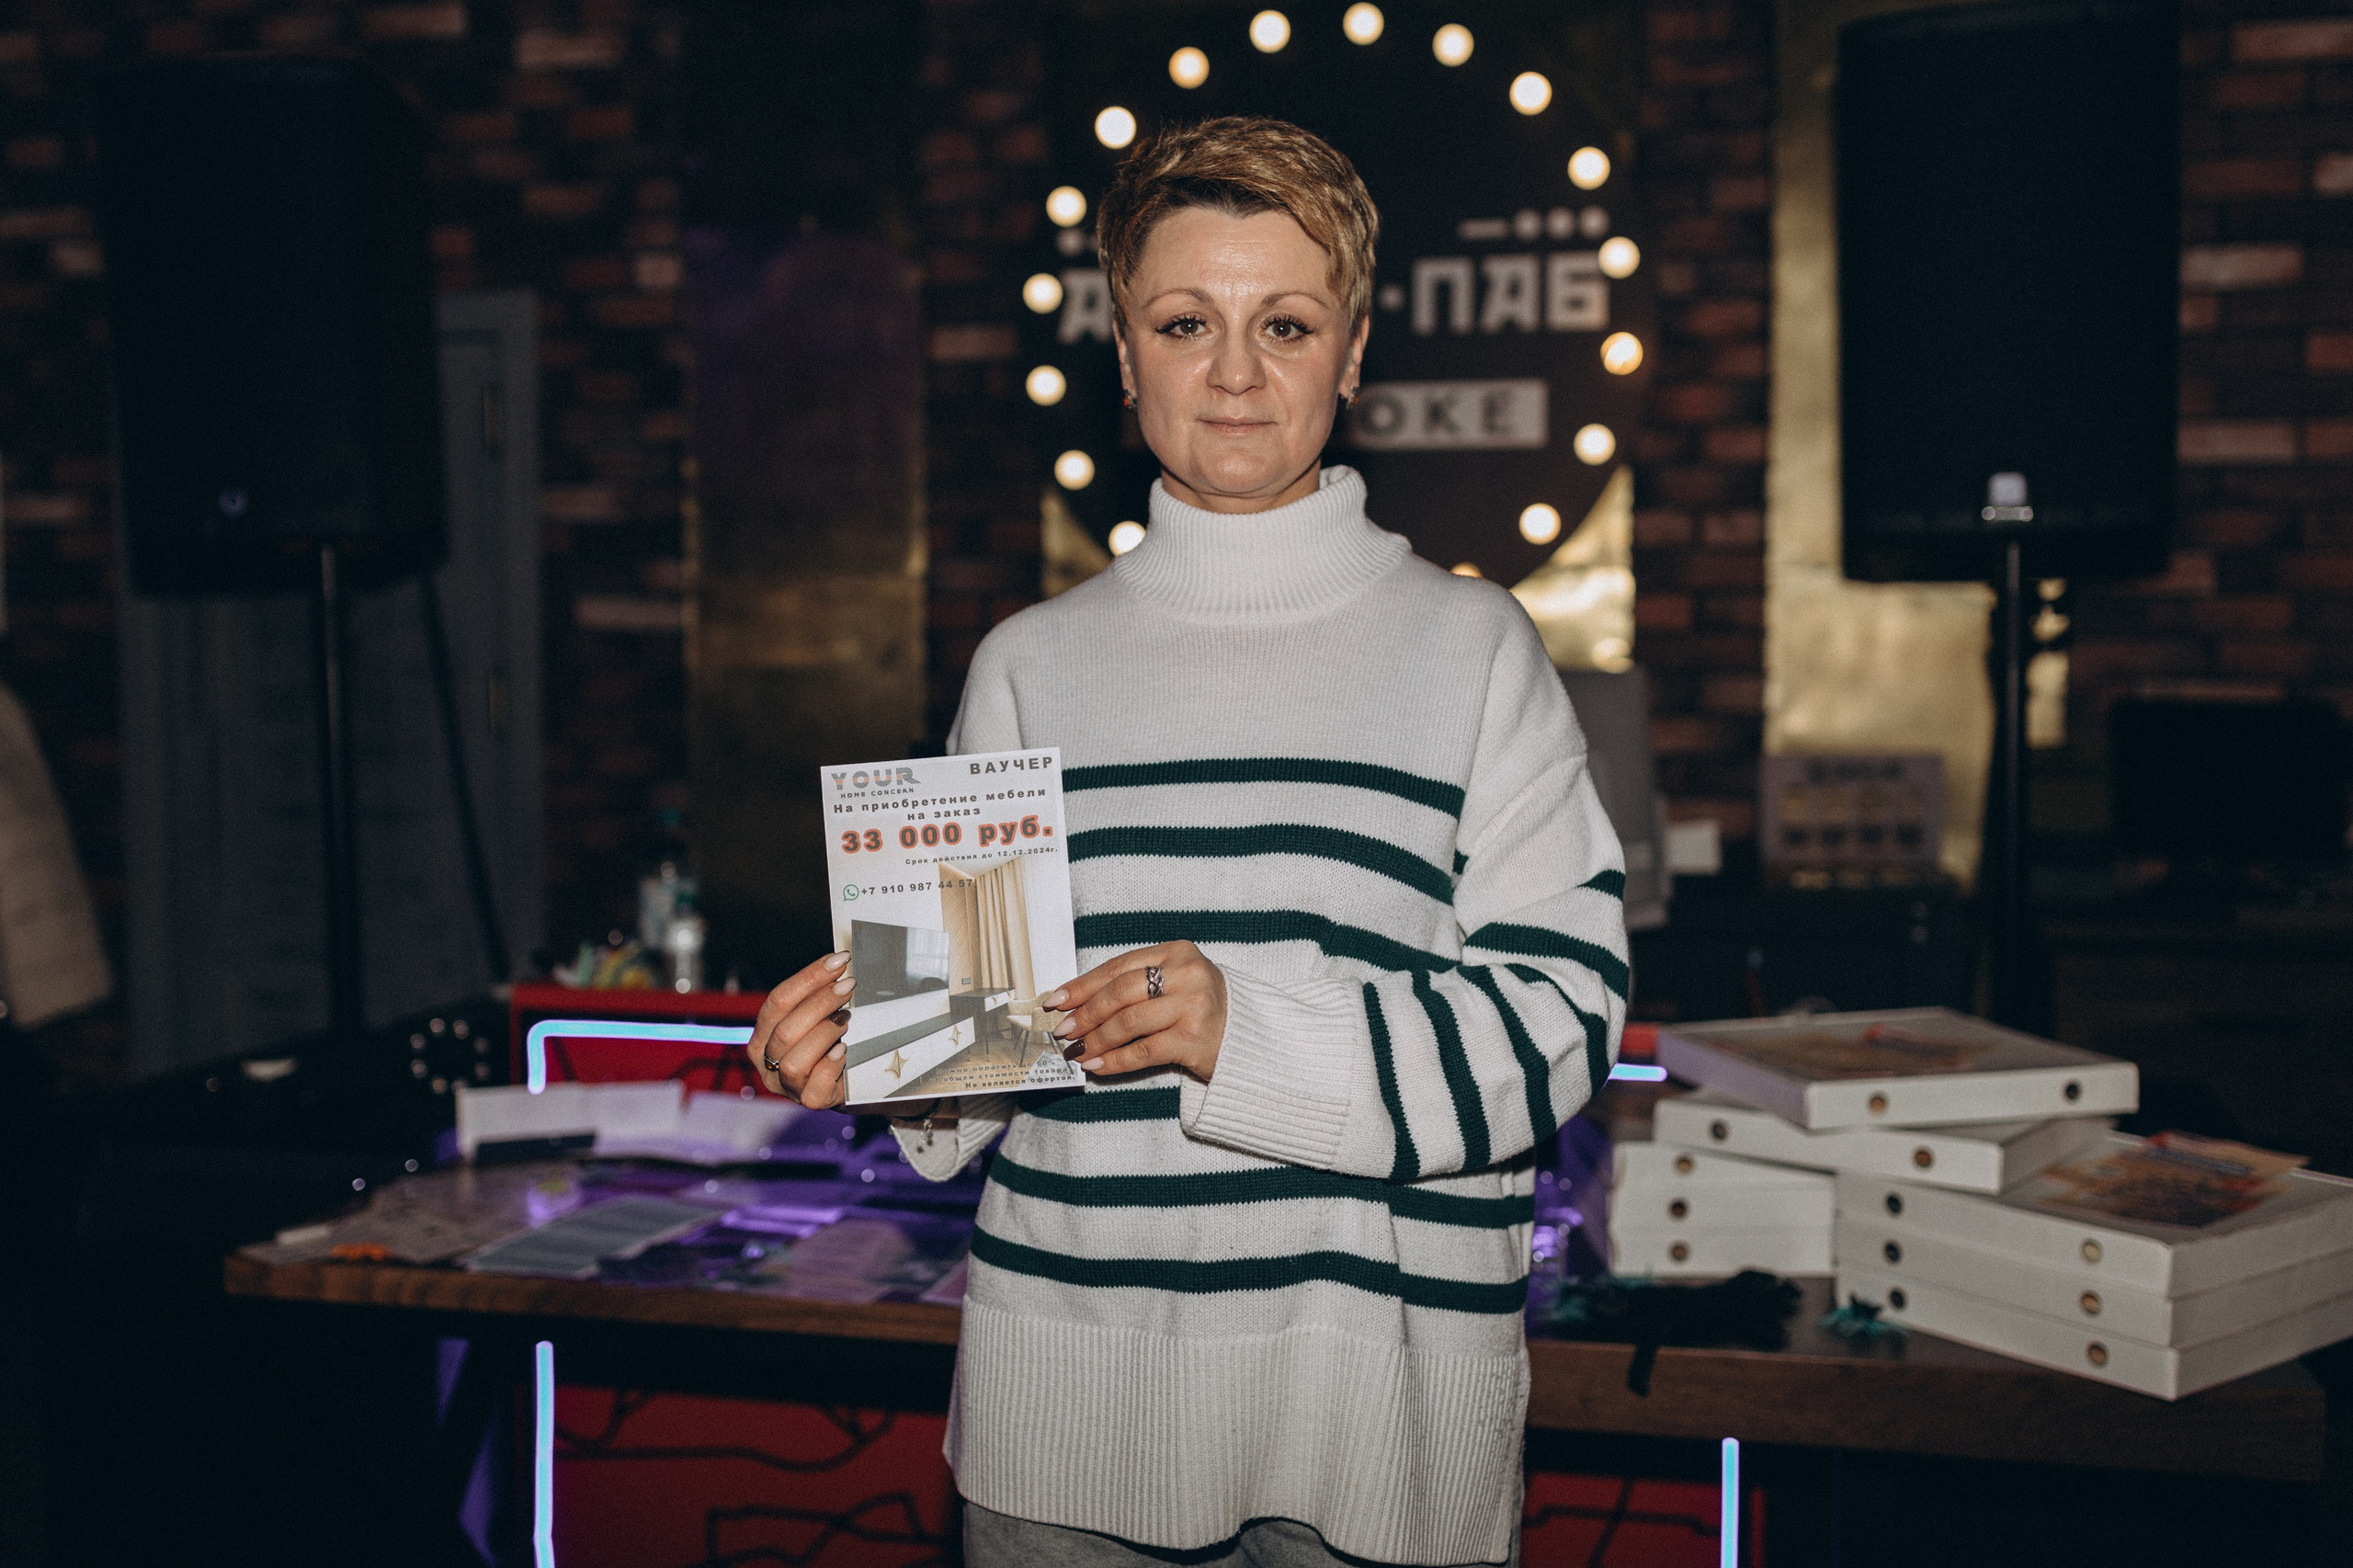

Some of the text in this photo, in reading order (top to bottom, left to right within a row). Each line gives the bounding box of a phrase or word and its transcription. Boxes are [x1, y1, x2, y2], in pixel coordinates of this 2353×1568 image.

[970, 756, 1052, 775] ВАУЧЕР
[831, 767, 921, 790] YOUR
[871, 788, 915, 797] CONCERN
[834, 789, 1046, 813] На приобретение мебели
[907, 808, 981, 821] на заказ
[842, 814, 1053, 854] 33 000 руб.
[905, 858, 928, 866] Срок
[932, 854, 977, 864] действия
[997, 847, 1058, 857] 12.12.2024г.
[861, 879, 972, 895] +7 910 987 44 57
[973, 1063, 1017, 1072] оплатить
[979, 1071, 1029, 1079] стоимости
[982, 1079, 1026, 1087] является
[1030, 1074, 1075, 1084] офертой.
